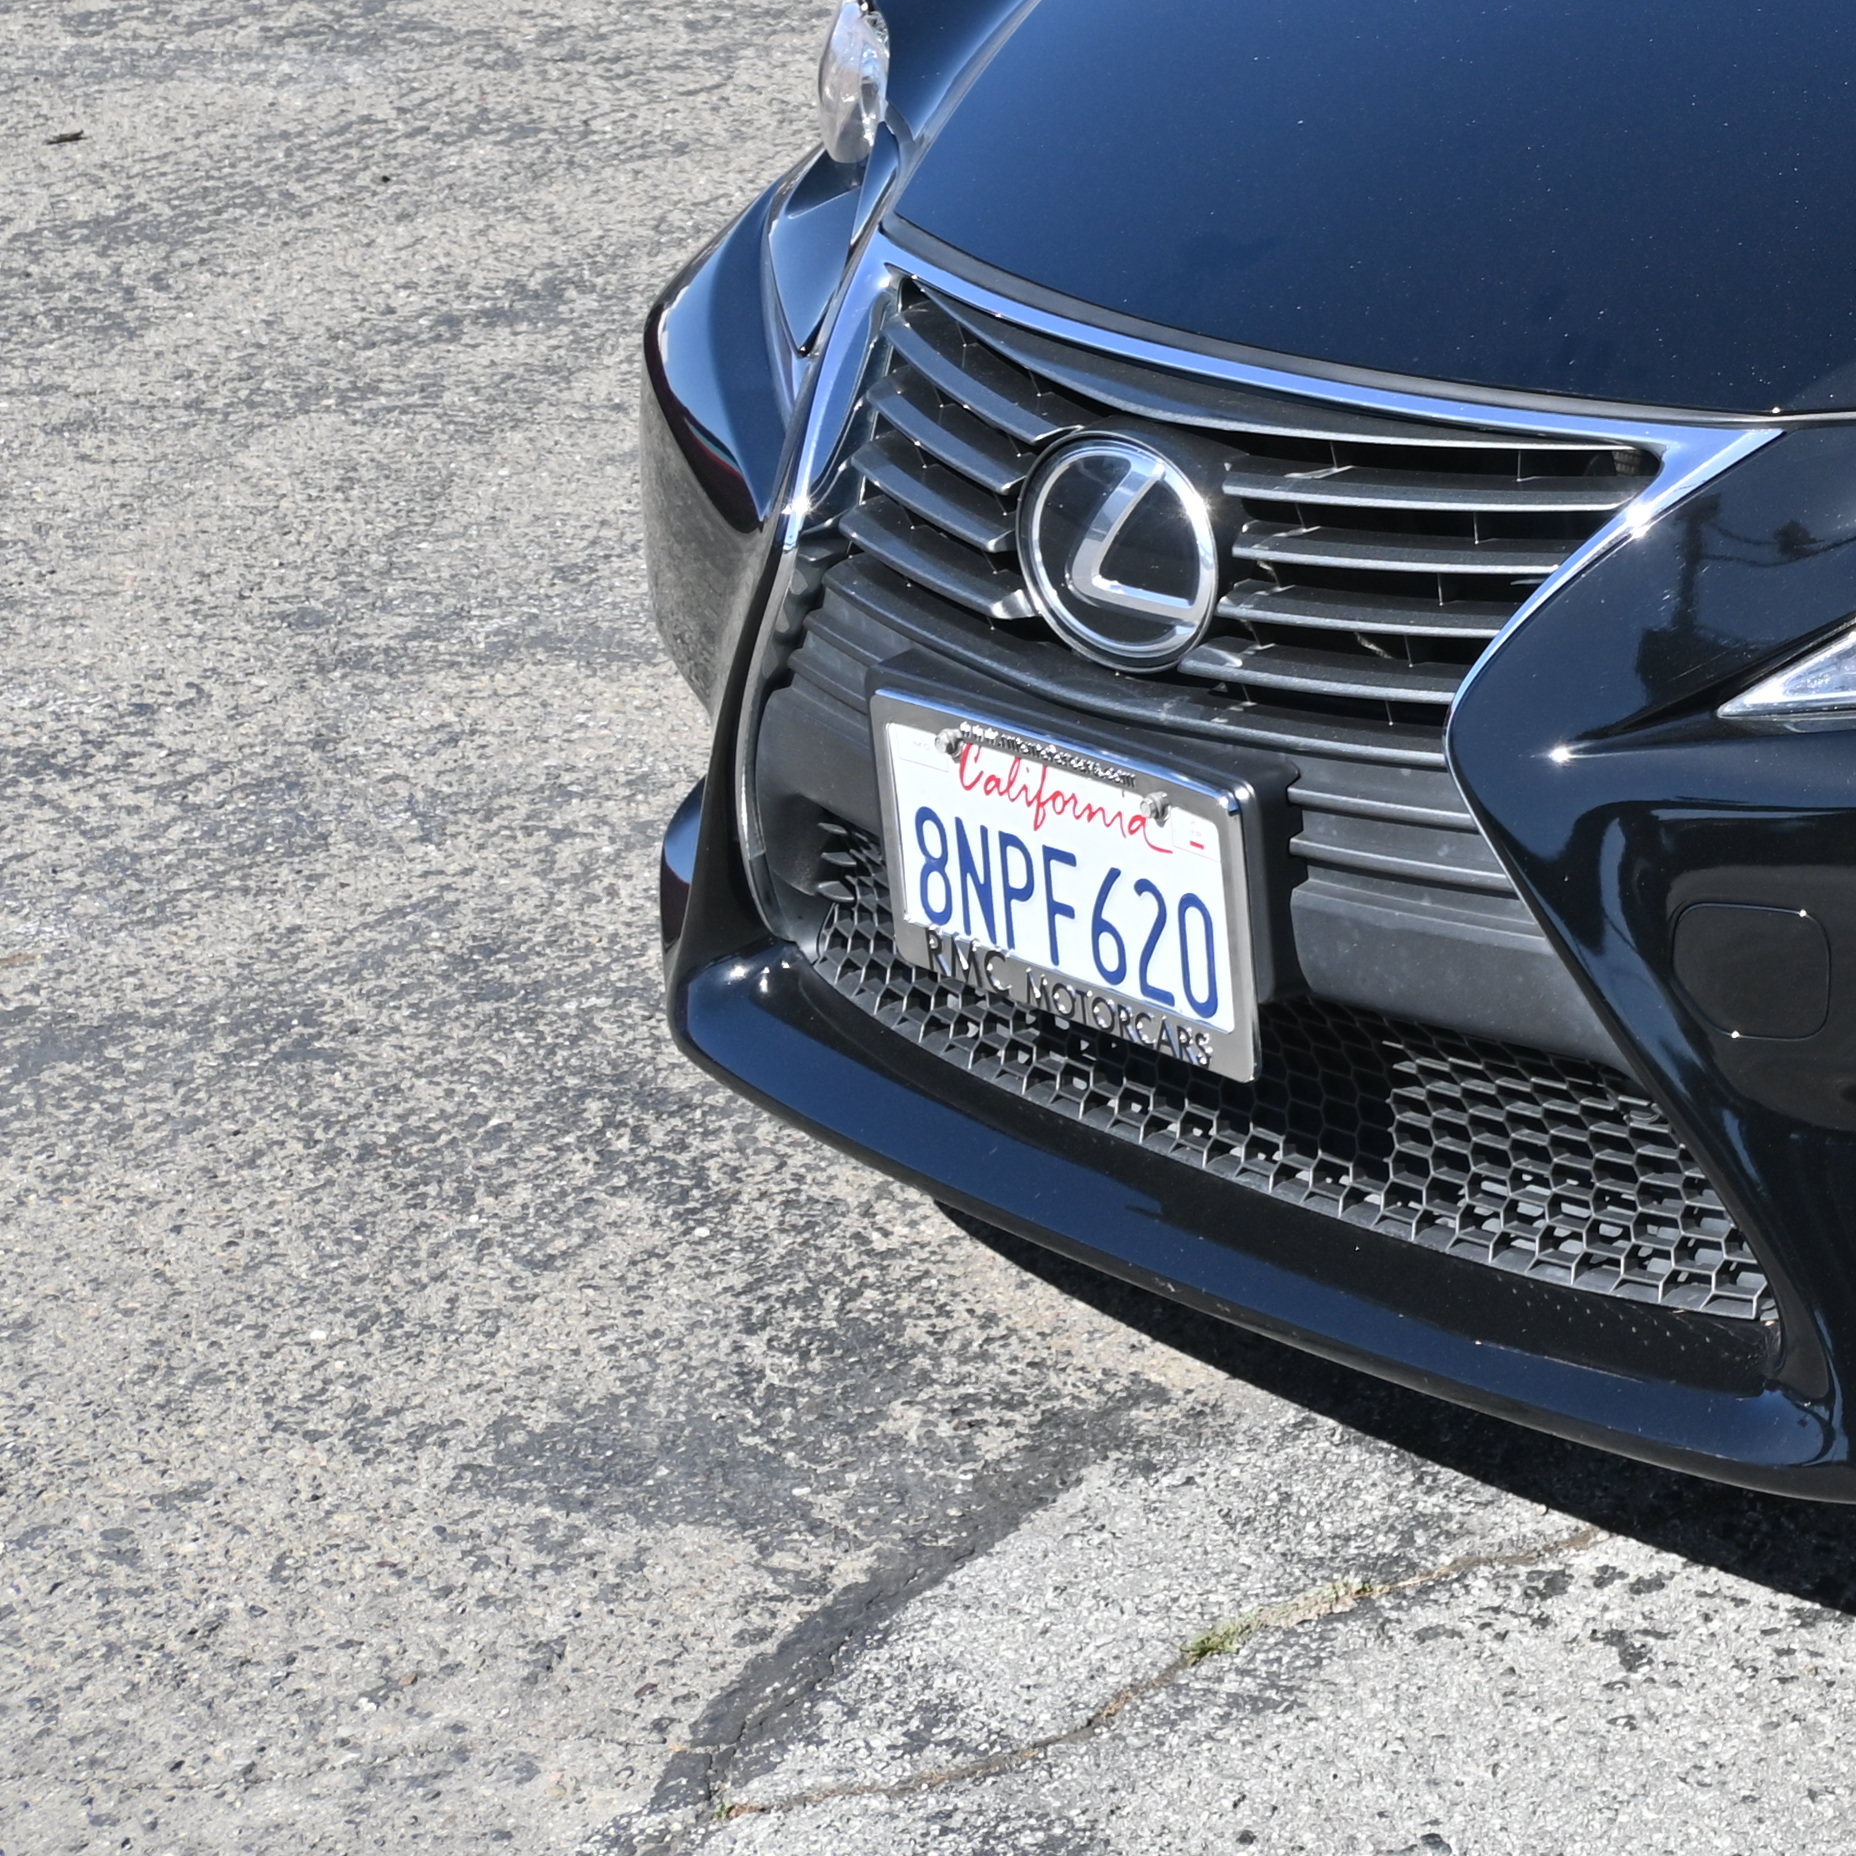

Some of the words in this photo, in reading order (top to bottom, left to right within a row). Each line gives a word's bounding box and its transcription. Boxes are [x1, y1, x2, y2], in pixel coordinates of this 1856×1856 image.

[960, 742, 1173, 855] California
[914, 805, 1219, 1020] 8NPF620
[925, 925, 1013, 994] RMC
[1025, 967, 1214, 1068] MOTORCARS
